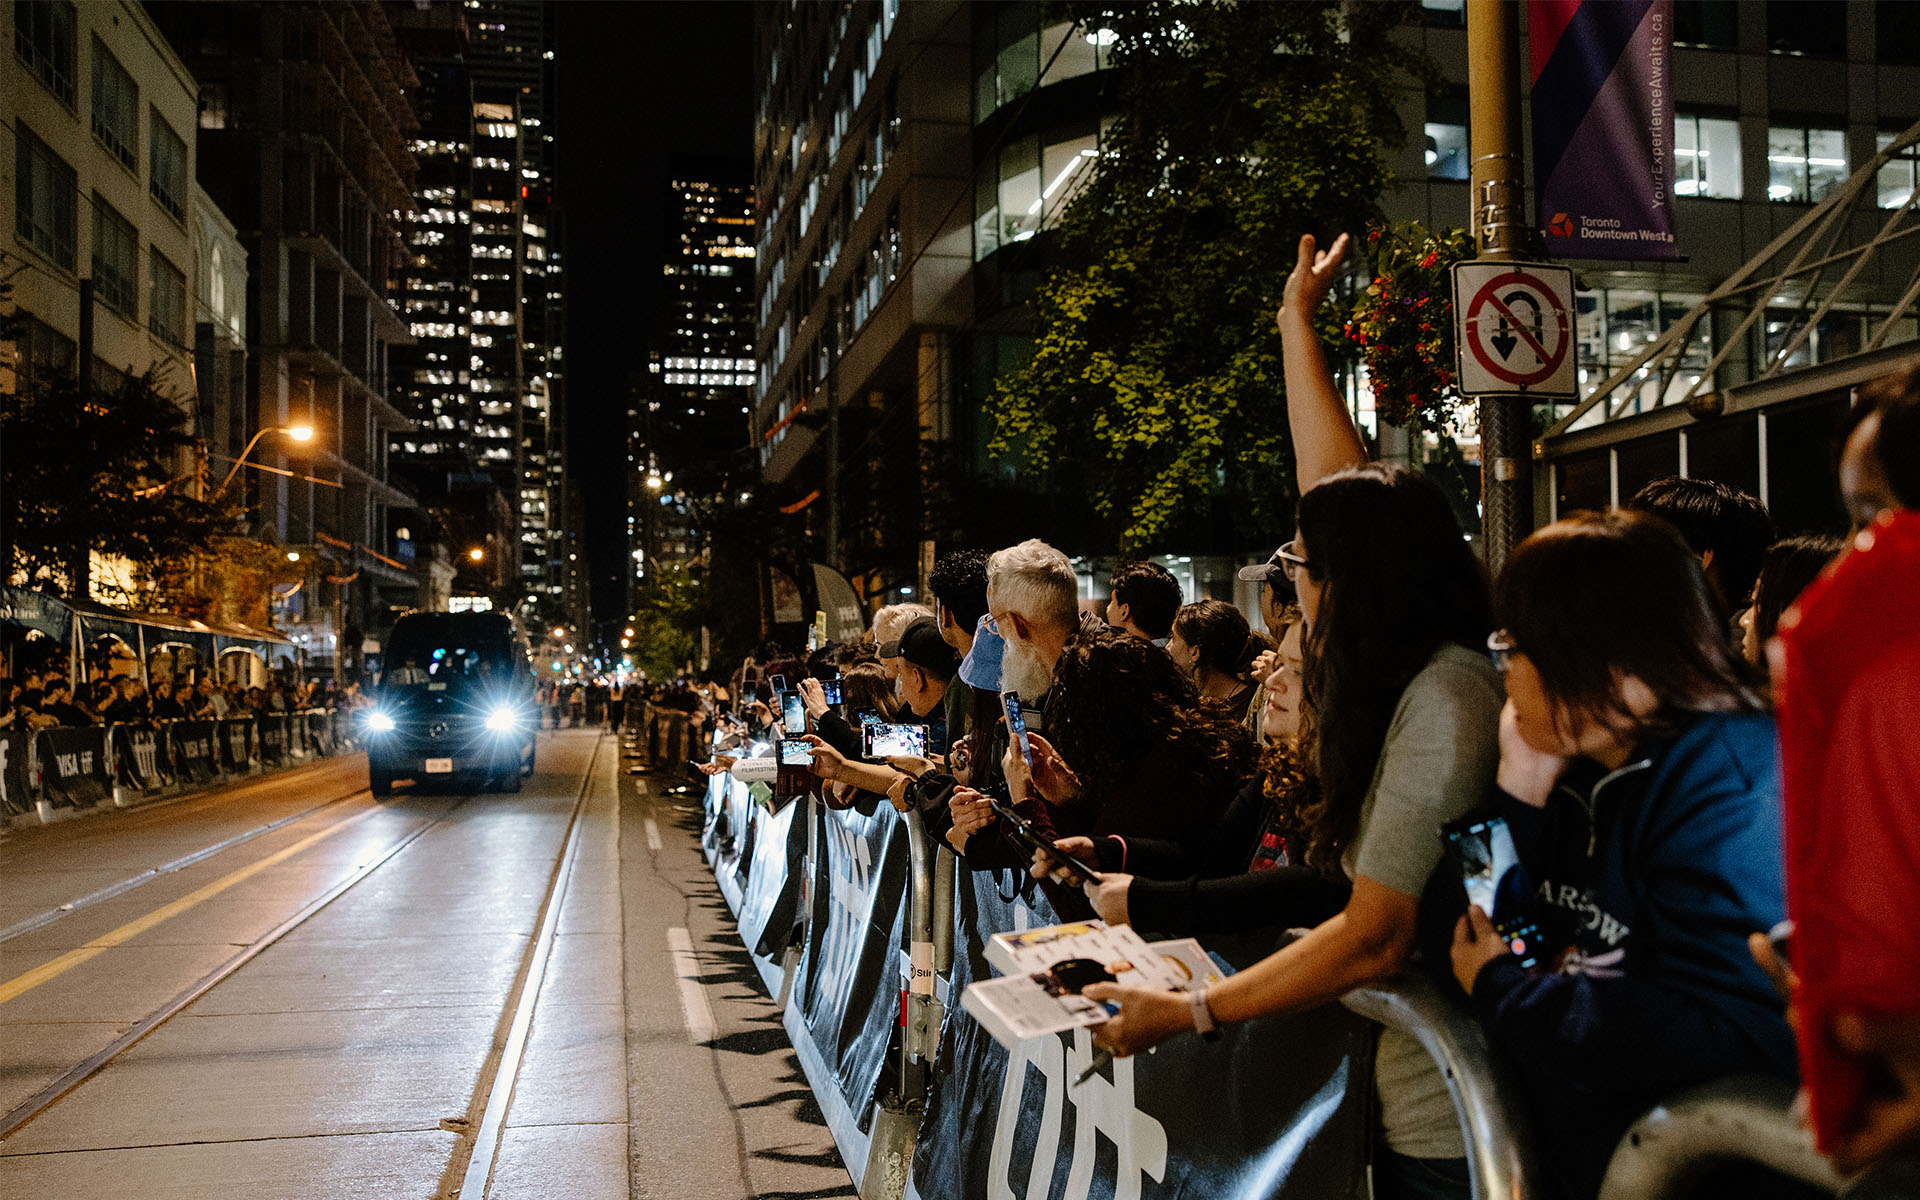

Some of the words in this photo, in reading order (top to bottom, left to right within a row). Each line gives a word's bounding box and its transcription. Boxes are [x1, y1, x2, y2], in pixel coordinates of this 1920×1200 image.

[1649, 13, 1664, 209] YourExperienceAwaits.ca
[1581, 215, 1621, 228] Toronto
[1581, 227, 1638, 240] Downtown
[1639, 229, 1667, 240] West
[56, 753, 80, 778] VISA
